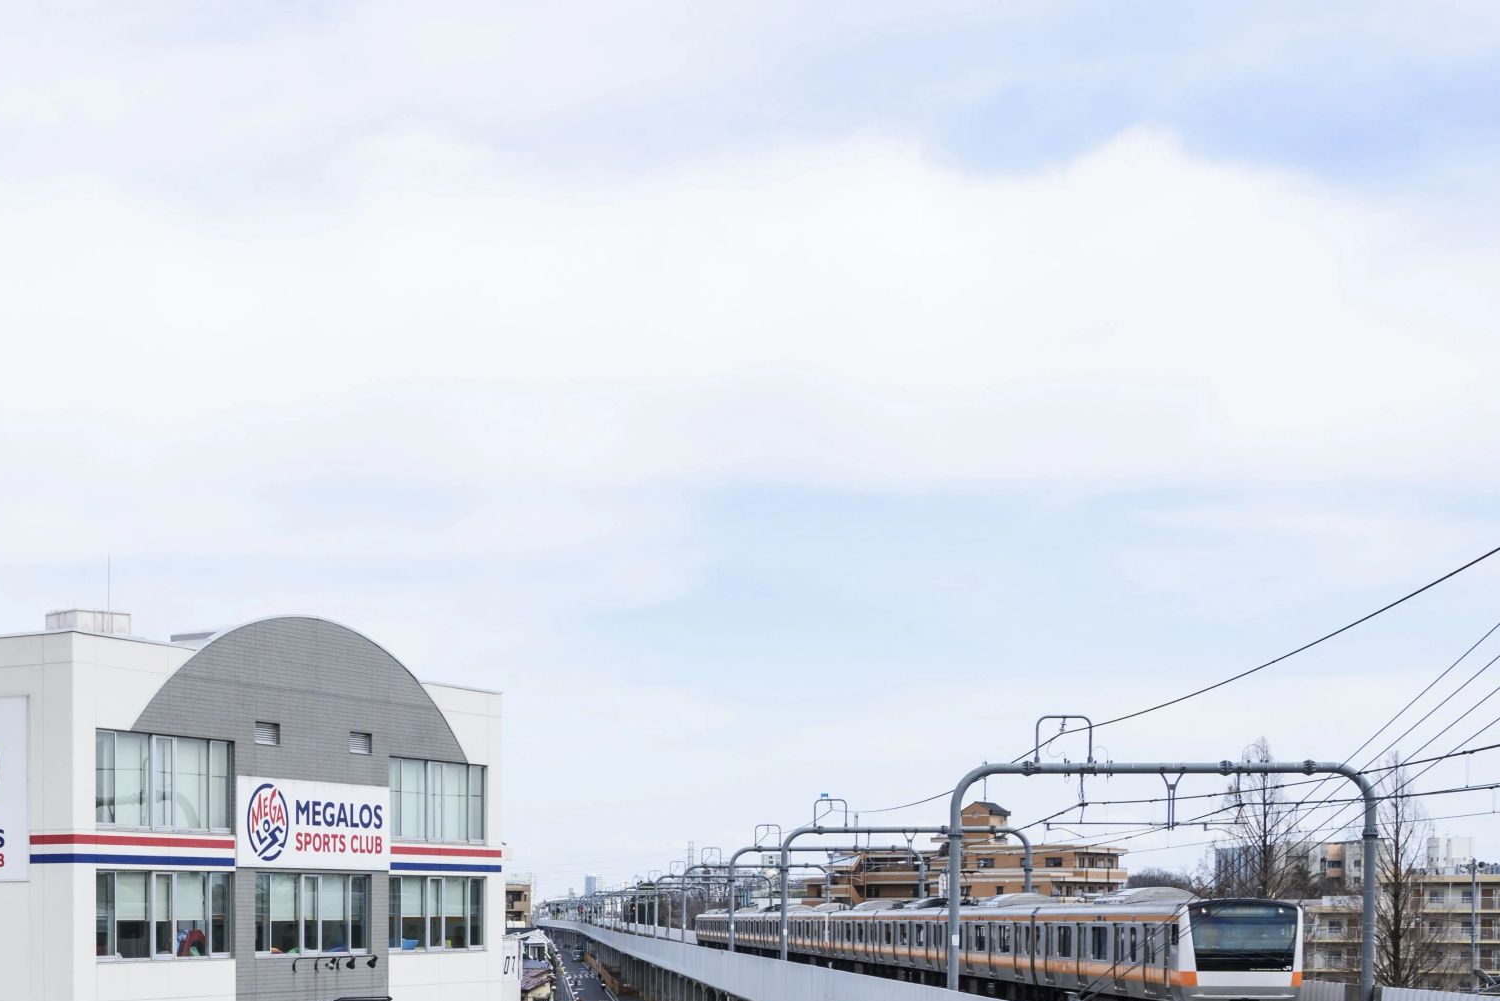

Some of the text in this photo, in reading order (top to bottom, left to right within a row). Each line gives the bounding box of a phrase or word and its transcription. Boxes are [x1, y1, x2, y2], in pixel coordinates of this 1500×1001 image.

[251, 788, 286, 834] MEGA
[295, 799, 383, 829] MEGALOS
[295, 832, 383, 854] SPORTS CLUB
